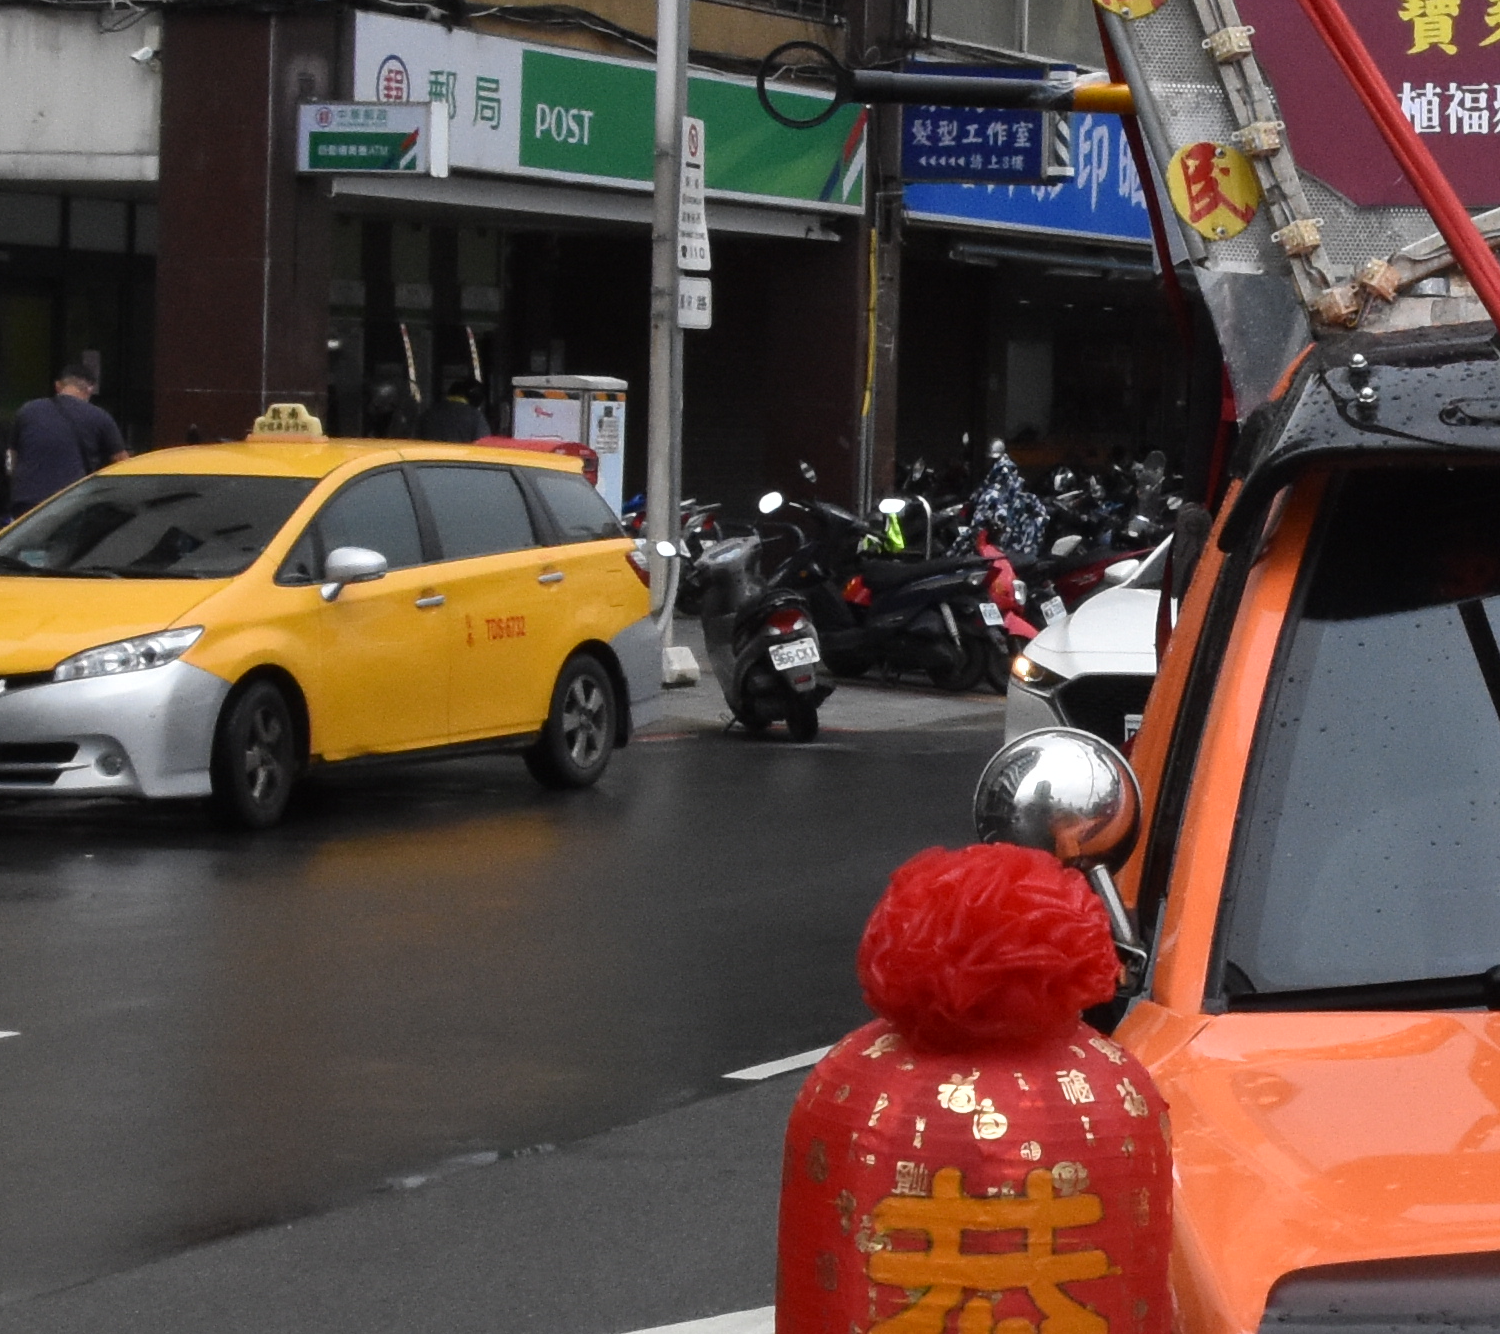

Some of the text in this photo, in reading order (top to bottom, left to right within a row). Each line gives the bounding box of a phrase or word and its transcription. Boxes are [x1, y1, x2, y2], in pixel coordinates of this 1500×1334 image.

[535, 104, 593, 144] POST
[912, 120, 1033, 147] 髮型工作室
